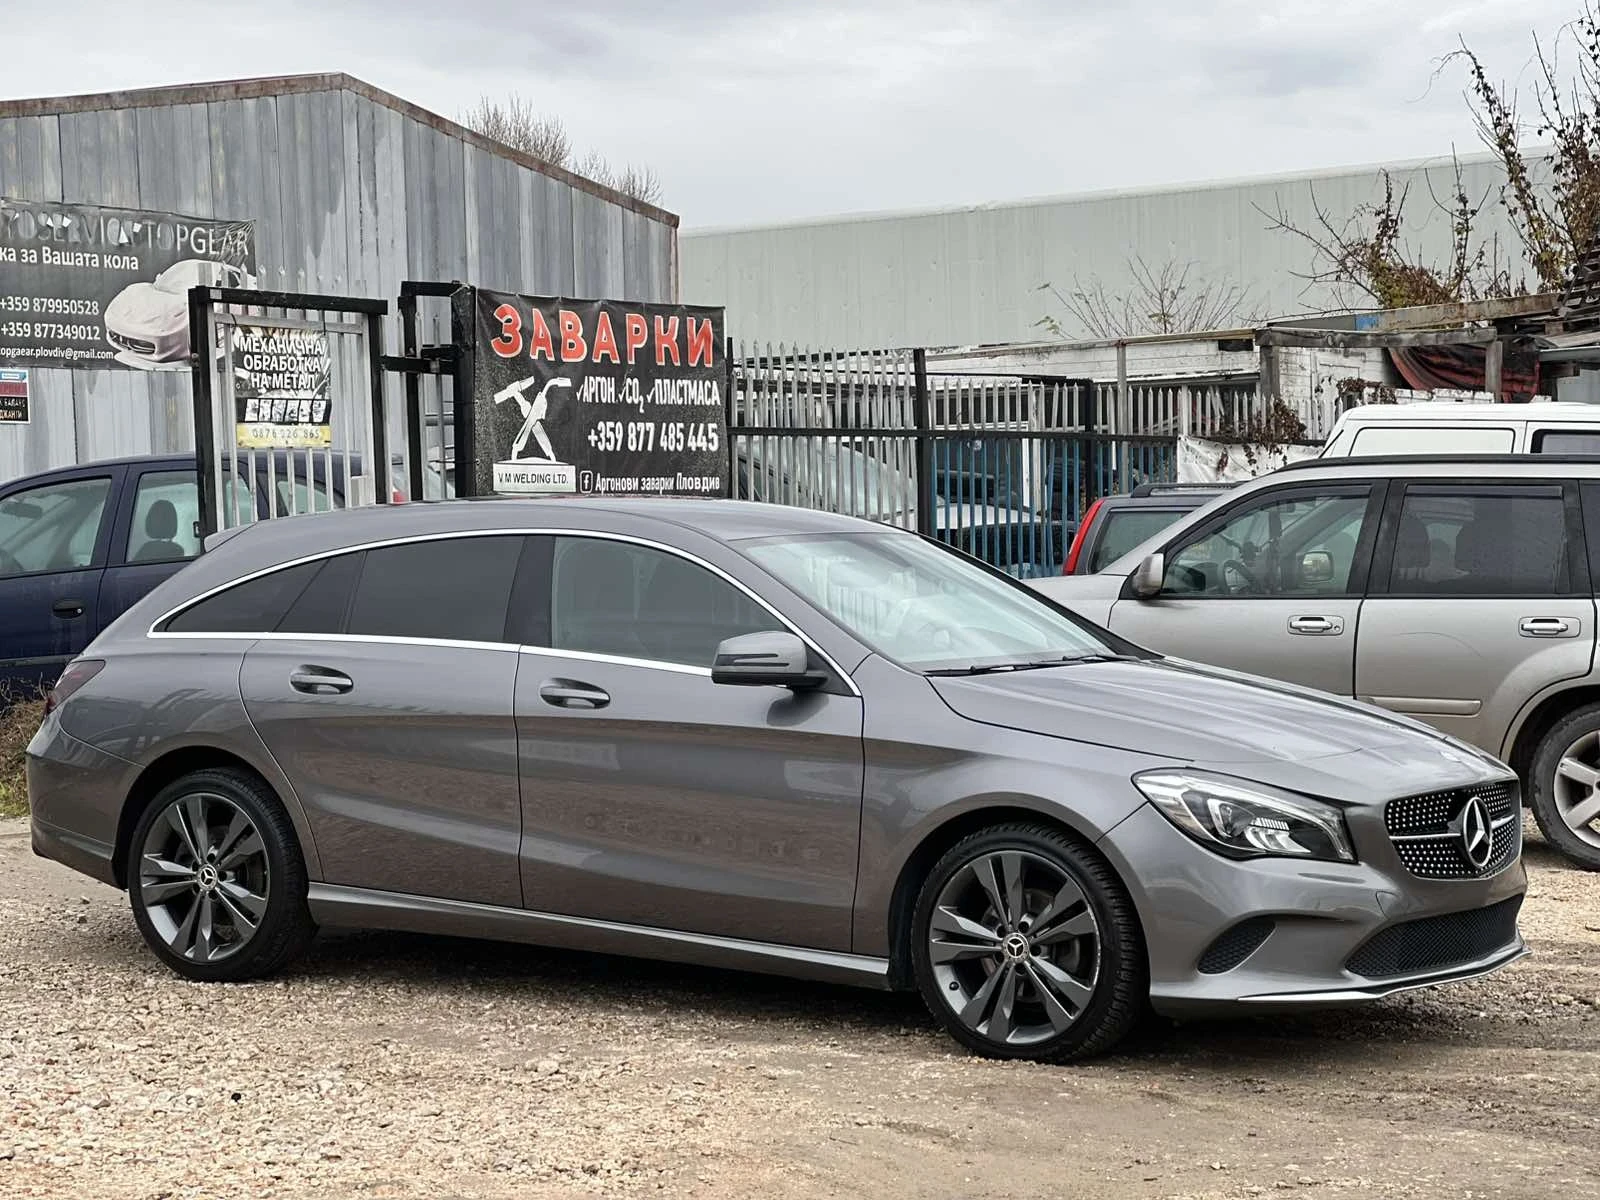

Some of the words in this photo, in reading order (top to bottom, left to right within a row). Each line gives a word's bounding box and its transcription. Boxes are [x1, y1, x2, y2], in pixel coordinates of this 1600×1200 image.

[21, 249, 37, 264] за
[42, 246, 99, 268] Вашата
[103, 254, 139, 271] кола
[0, 296, 30, 311] +359
[33, 297, 99, 315] 879950528
[1, 322, 31, 337] +359
[34, 322, 101, 340] 877349012
[490, 303, 714, 368] ЗАВАРКИ
[240, 336, 322, 355] МЕХАНИЧНА
[243, 354, 321, 372] ОБРАБОТКА
[251, 372, 269, 388] НА
[272, 373, 316, 389] МЕТАЛ
[655, 379, 721, 406] ПЛАСТМАСА
[588, 421, 624, 451] +359
[628, 422, 655, 451] 877
[660, 423, 684, 452] 485
[687, 423, 719, 452] 445
[513, 472, 551, 484] WELDING
[552, 473, 568, 485] LTD.
[596, 475, 639, 492] Аргонови
[641, 479, 674, 495] заварки
[677, 473, 720, 492] Пловдив
